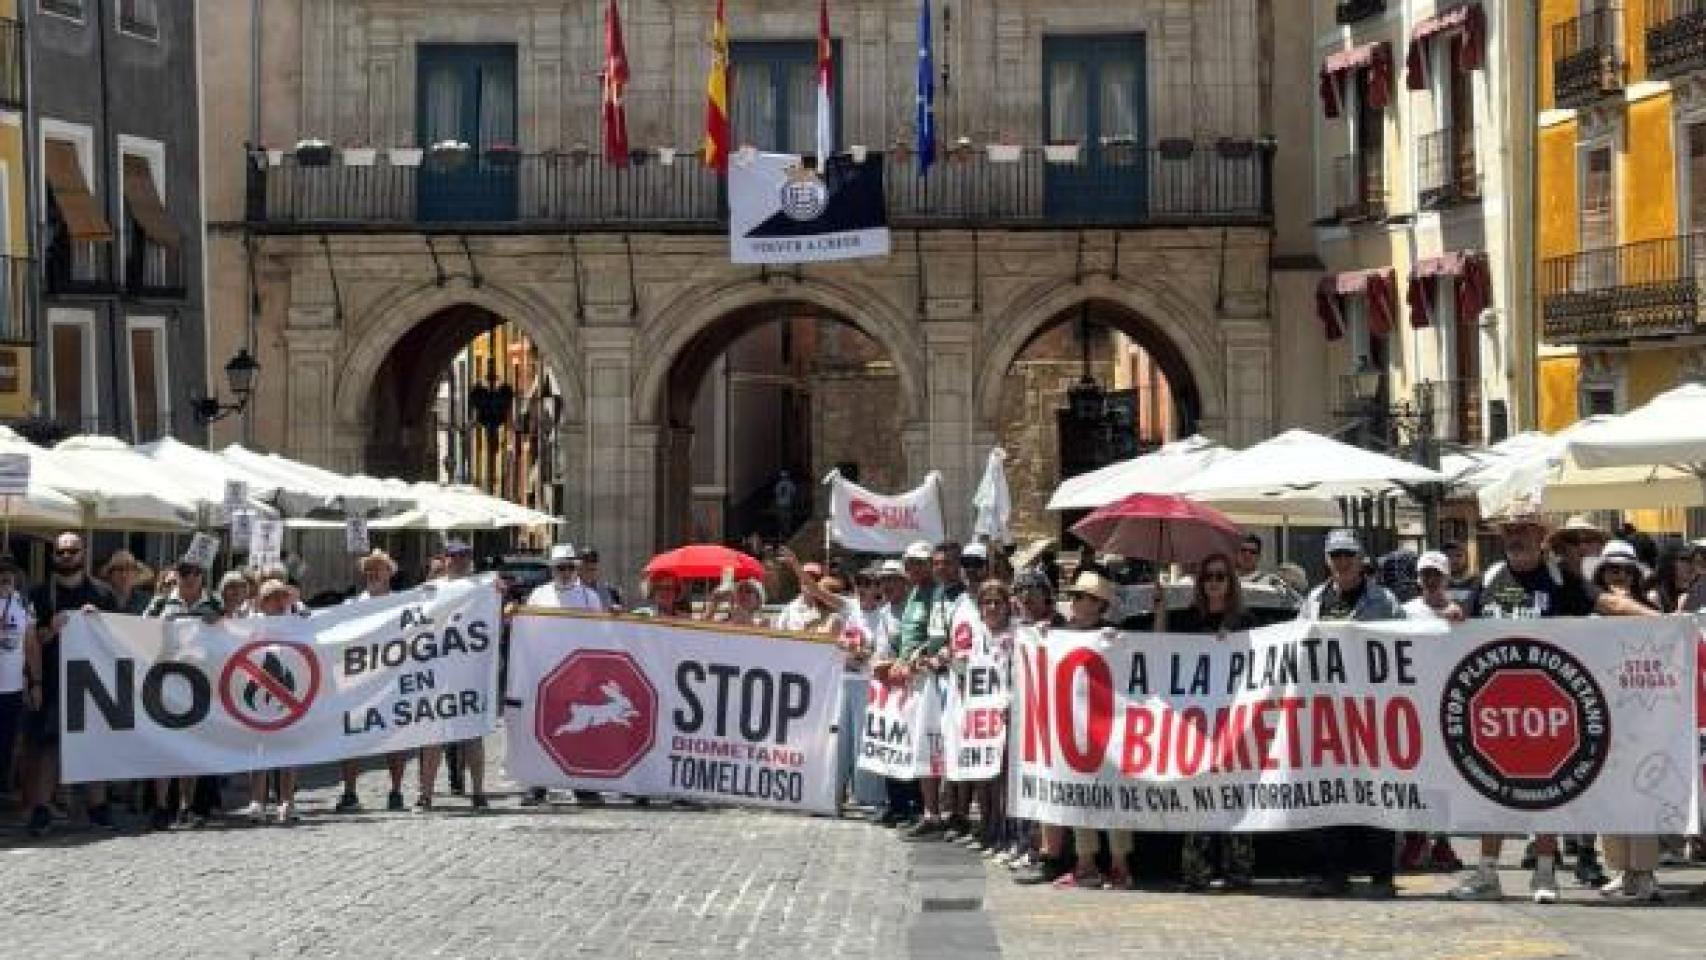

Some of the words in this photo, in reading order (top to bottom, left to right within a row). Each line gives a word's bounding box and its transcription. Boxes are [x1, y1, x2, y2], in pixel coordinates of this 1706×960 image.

[344, 612, 489, 675] BIOGÁS
[400, 607, 434, 630] AL
[400, 669, 435, 694] EN
[1128, 652, 1149, 695] A
[1171, 653, 1211, 695] LA
[1226, 638, 1347, 694] PLANTA
[1366, 639, 1417, 684] DE
[1448, 688, 1466, 736] STOP
[1459, 646, 1522, 687] PLANTA
[1529, 646, 1603, 735] BIOMETANO
[66, 658, 211, 733] NO
[344, 708, 386, 734] LA
[673, 660, 812, 743] STOP
[1020, 645, 1116, 774] NO
[1121, 694, 1424, 778] BIOMETANO
[1479, 707, 1570, 737] STOP
[672, 736, 806, 766] BIOMETANO
[668, 755, 804, 802] TOMELLOSO
[1119, 784, 1144, 812] DE
[1146, 785, 1189, 812] CVA.
[1193, 785, 1216, 812] NI
[1220, 783, 1245, 810] EN
[1249, 777, 1348, 809] TORRALBA
[1353, 778, 1377, 807] DE
[1380, 780, 1427, 809] CVA.
